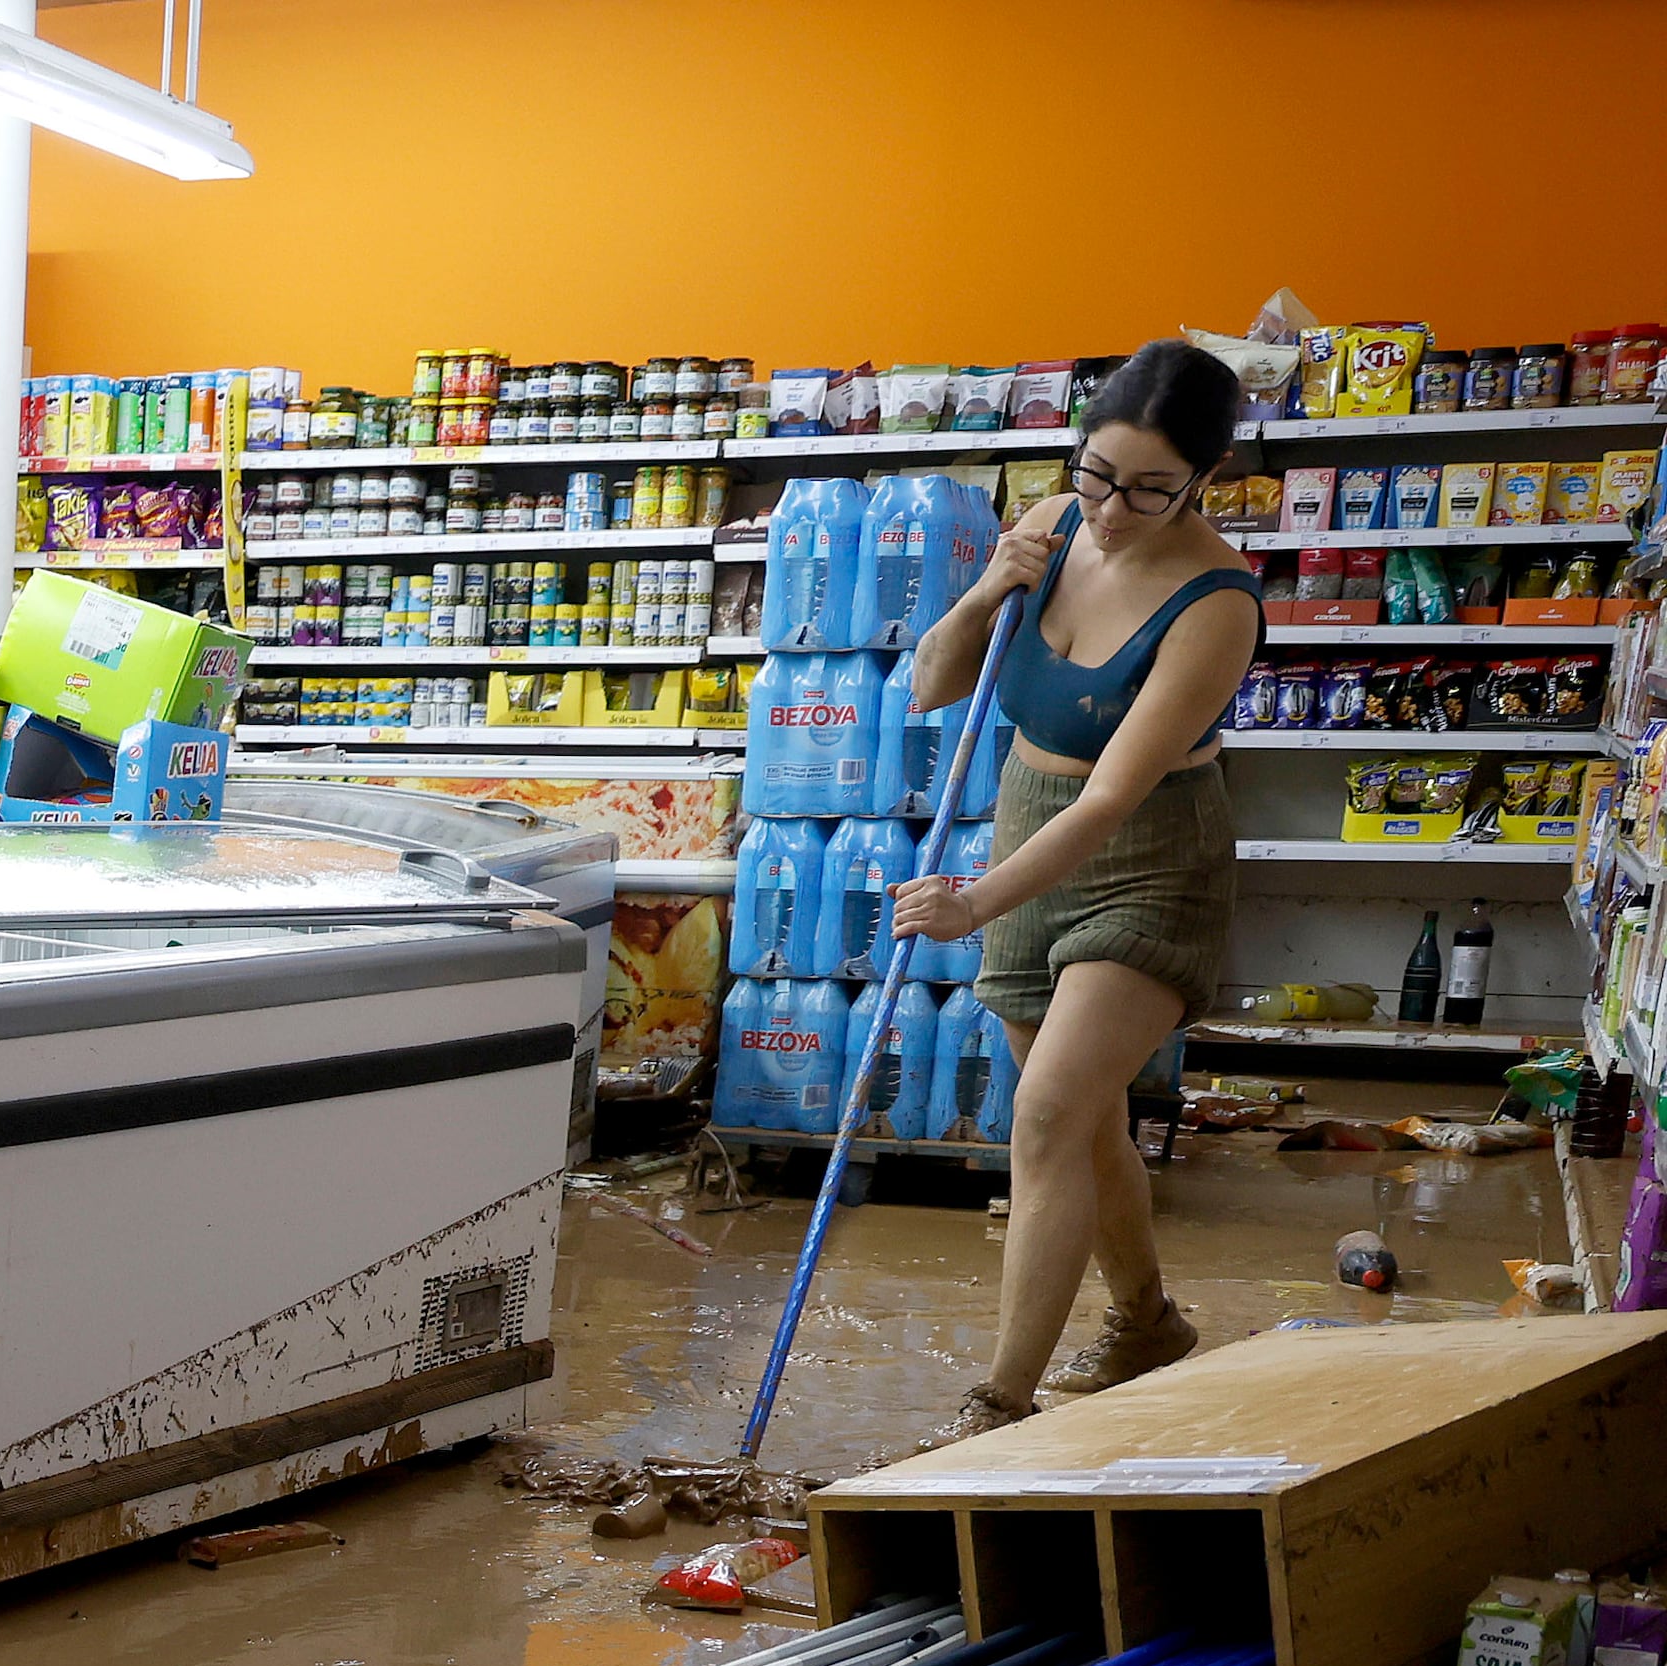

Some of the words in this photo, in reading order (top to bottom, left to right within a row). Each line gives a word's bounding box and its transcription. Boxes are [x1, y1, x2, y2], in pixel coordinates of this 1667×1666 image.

[1310, 333, 1332, 362] TUC
[1354, 342, 1405, 372] Krit
[53, 493, 88, 514] Takis
[1313, 613, 1352, 621] consum
[193, 647, 232, 678] KELIA
[1497, 662, 1537, 677] Grefusa
[1552, 659, 1593, 675] Grefusa
[510, 714, 541, 726] Jolca
[608, 713, 638, 725] Jolca
[706, 713, 737, 725] Jolca
[769, 704, 858, 726] BEZOYA
[1506, 714, 1561, 724] MisterCorn
[169, 742, 218, 777] KELIA
[741, 1030, 821, 1051] BEZOYA
[1479, 1632, 1530, 1650] consum
